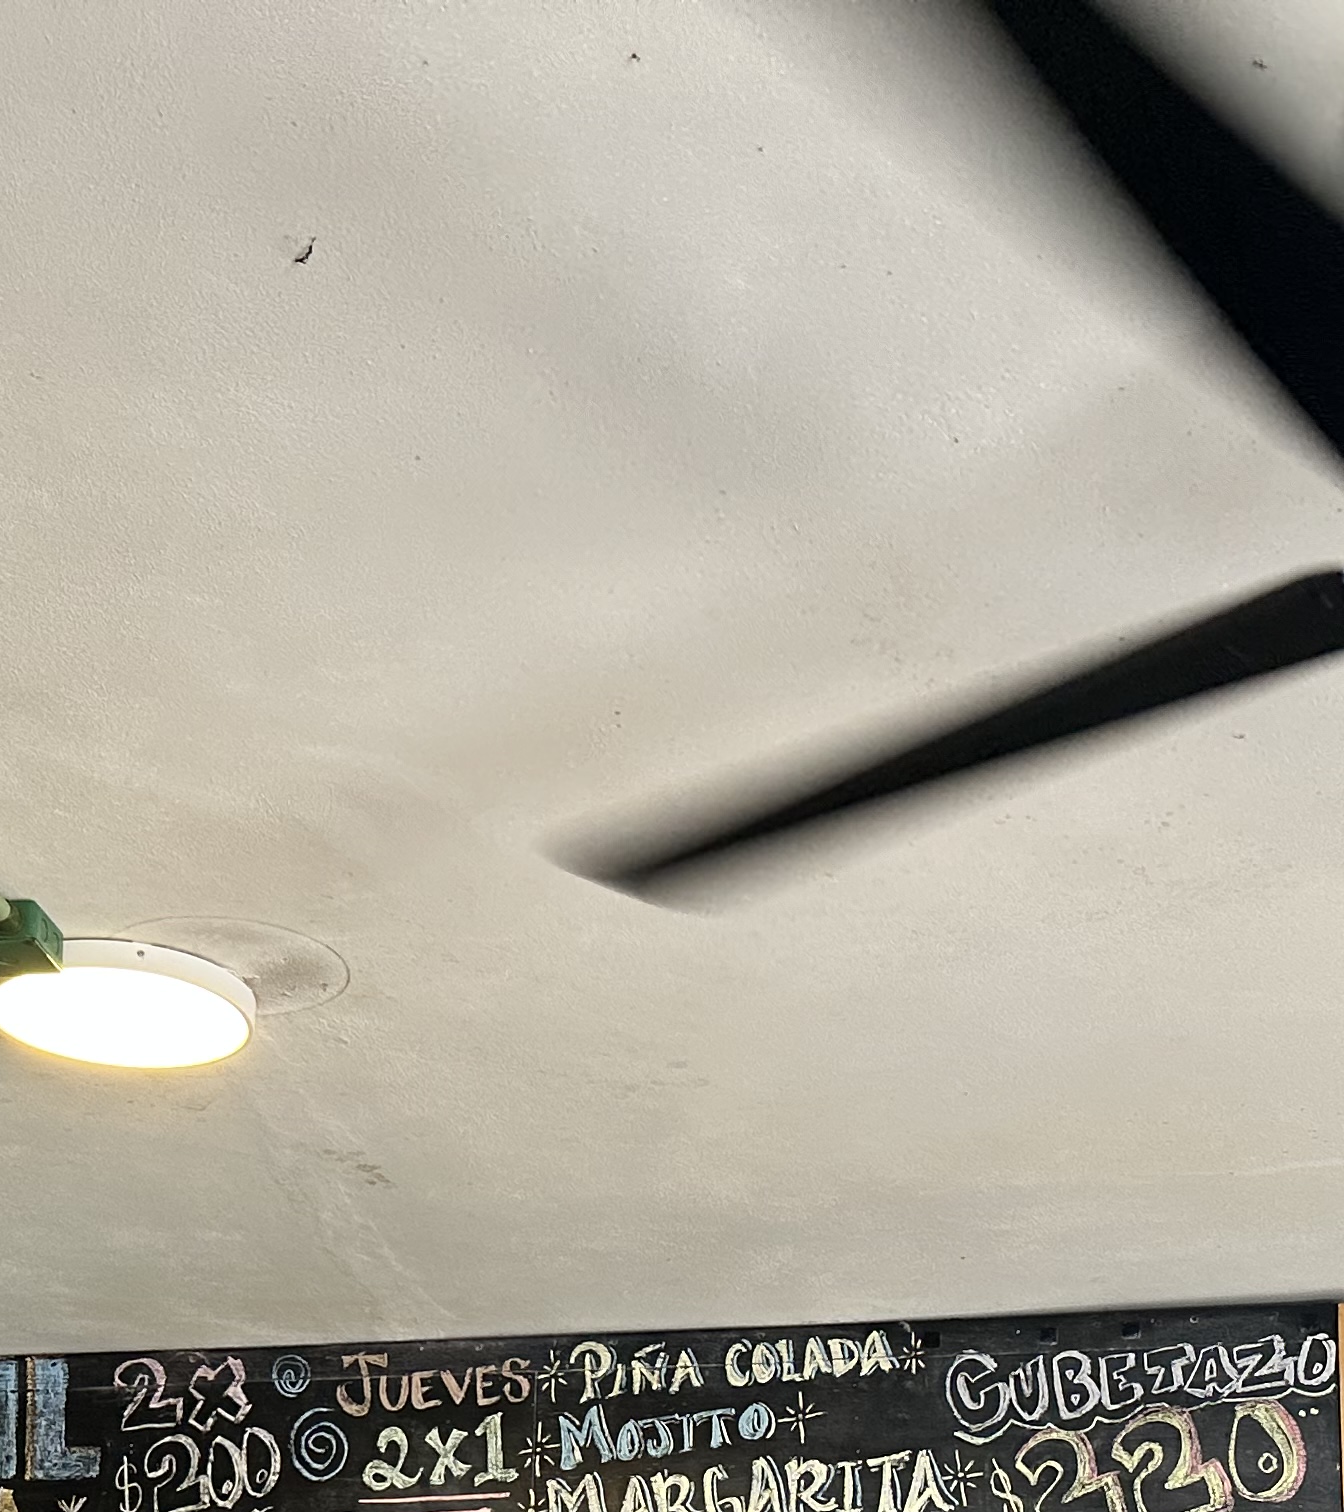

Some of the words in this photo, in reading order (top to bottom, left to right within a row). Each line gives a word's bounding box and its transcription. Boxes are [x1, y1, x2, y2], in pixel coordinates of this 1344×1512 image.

[335, 1352, 532, 1417] JUEVES
[568, 1340, 703, 1405] PIÑA
[724, 1329, 900, 1388] COLADA
[559, 1402, 776, 1471] MOJITO
